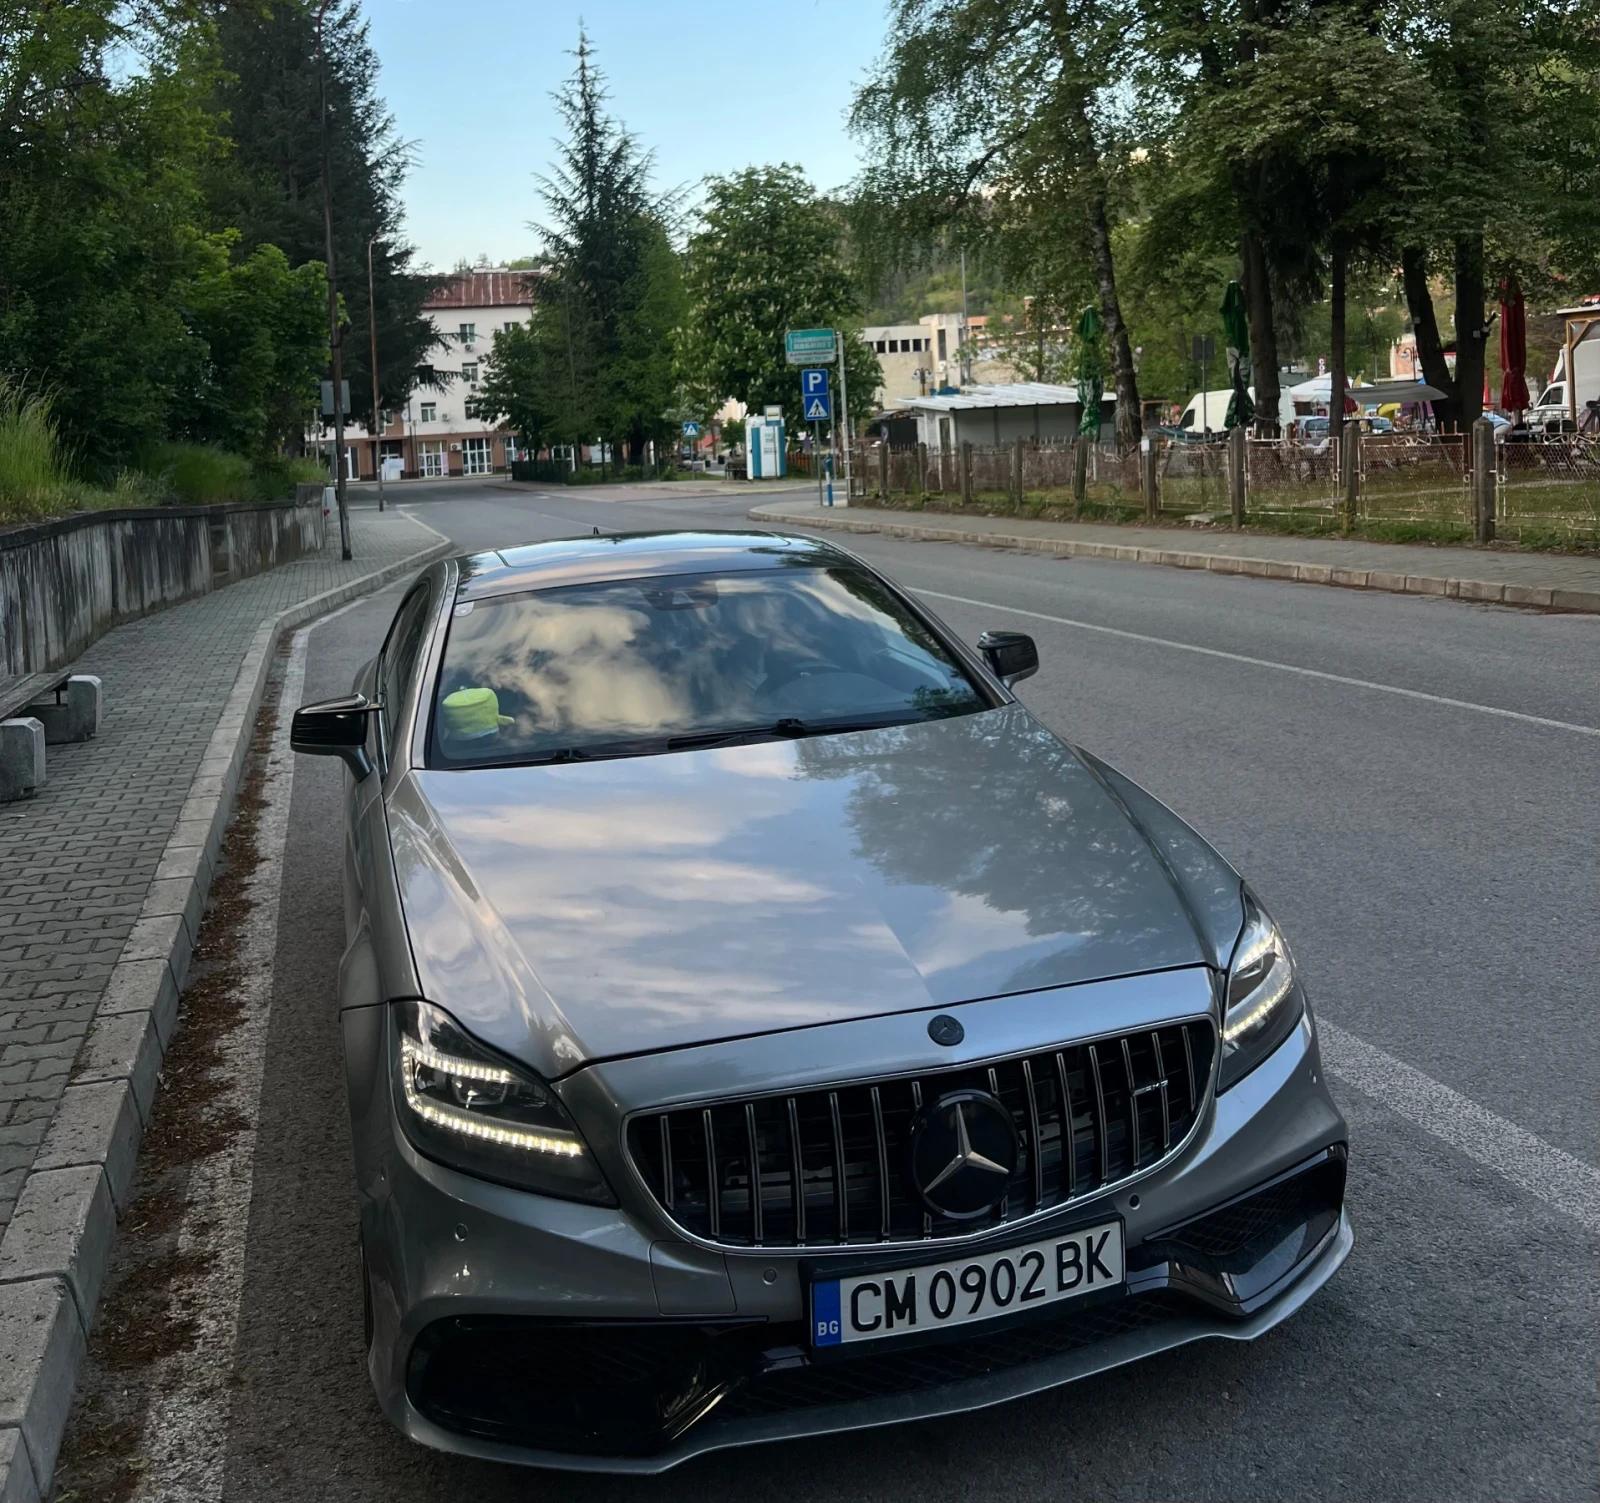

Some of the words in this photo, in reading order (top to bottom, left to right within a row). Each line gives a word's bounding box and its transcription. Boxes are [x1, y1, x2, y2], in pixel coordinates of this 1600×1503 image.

[808, 372, 823, 392] P
[850, 1275, 917, 1332] CM
[929, 1251, 1046, 1319] 0902
[1055, 1229, 1113, 1292] BK
[817, 1320, 839, 1337] BG
